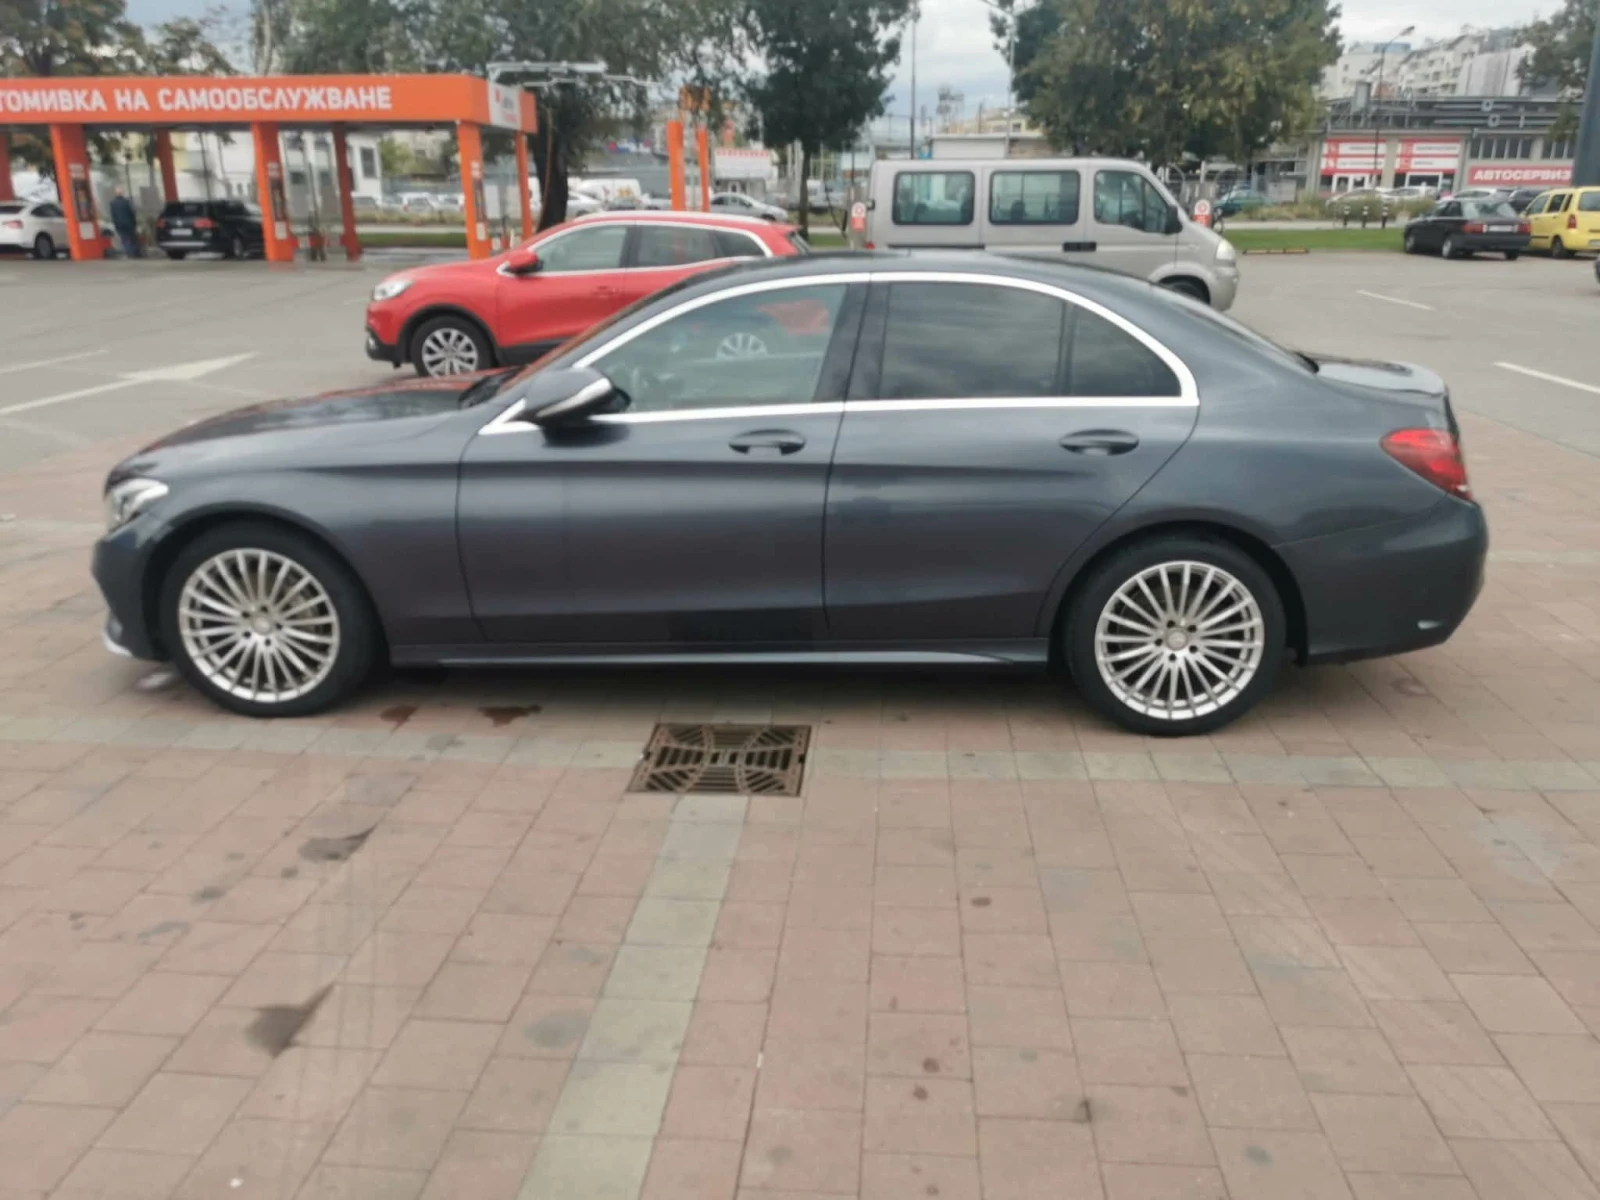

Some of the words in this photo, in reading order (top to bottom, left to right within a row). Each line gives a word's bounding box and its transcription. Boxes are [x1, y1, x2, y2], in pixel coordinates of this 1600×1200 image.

[113, 87, 150, 112] НА
[157, 86, 392, 111] САМООБСЛУЖВАНЕ
[1473, 168, 1572, 181] АВТОСЕРВИЗ
